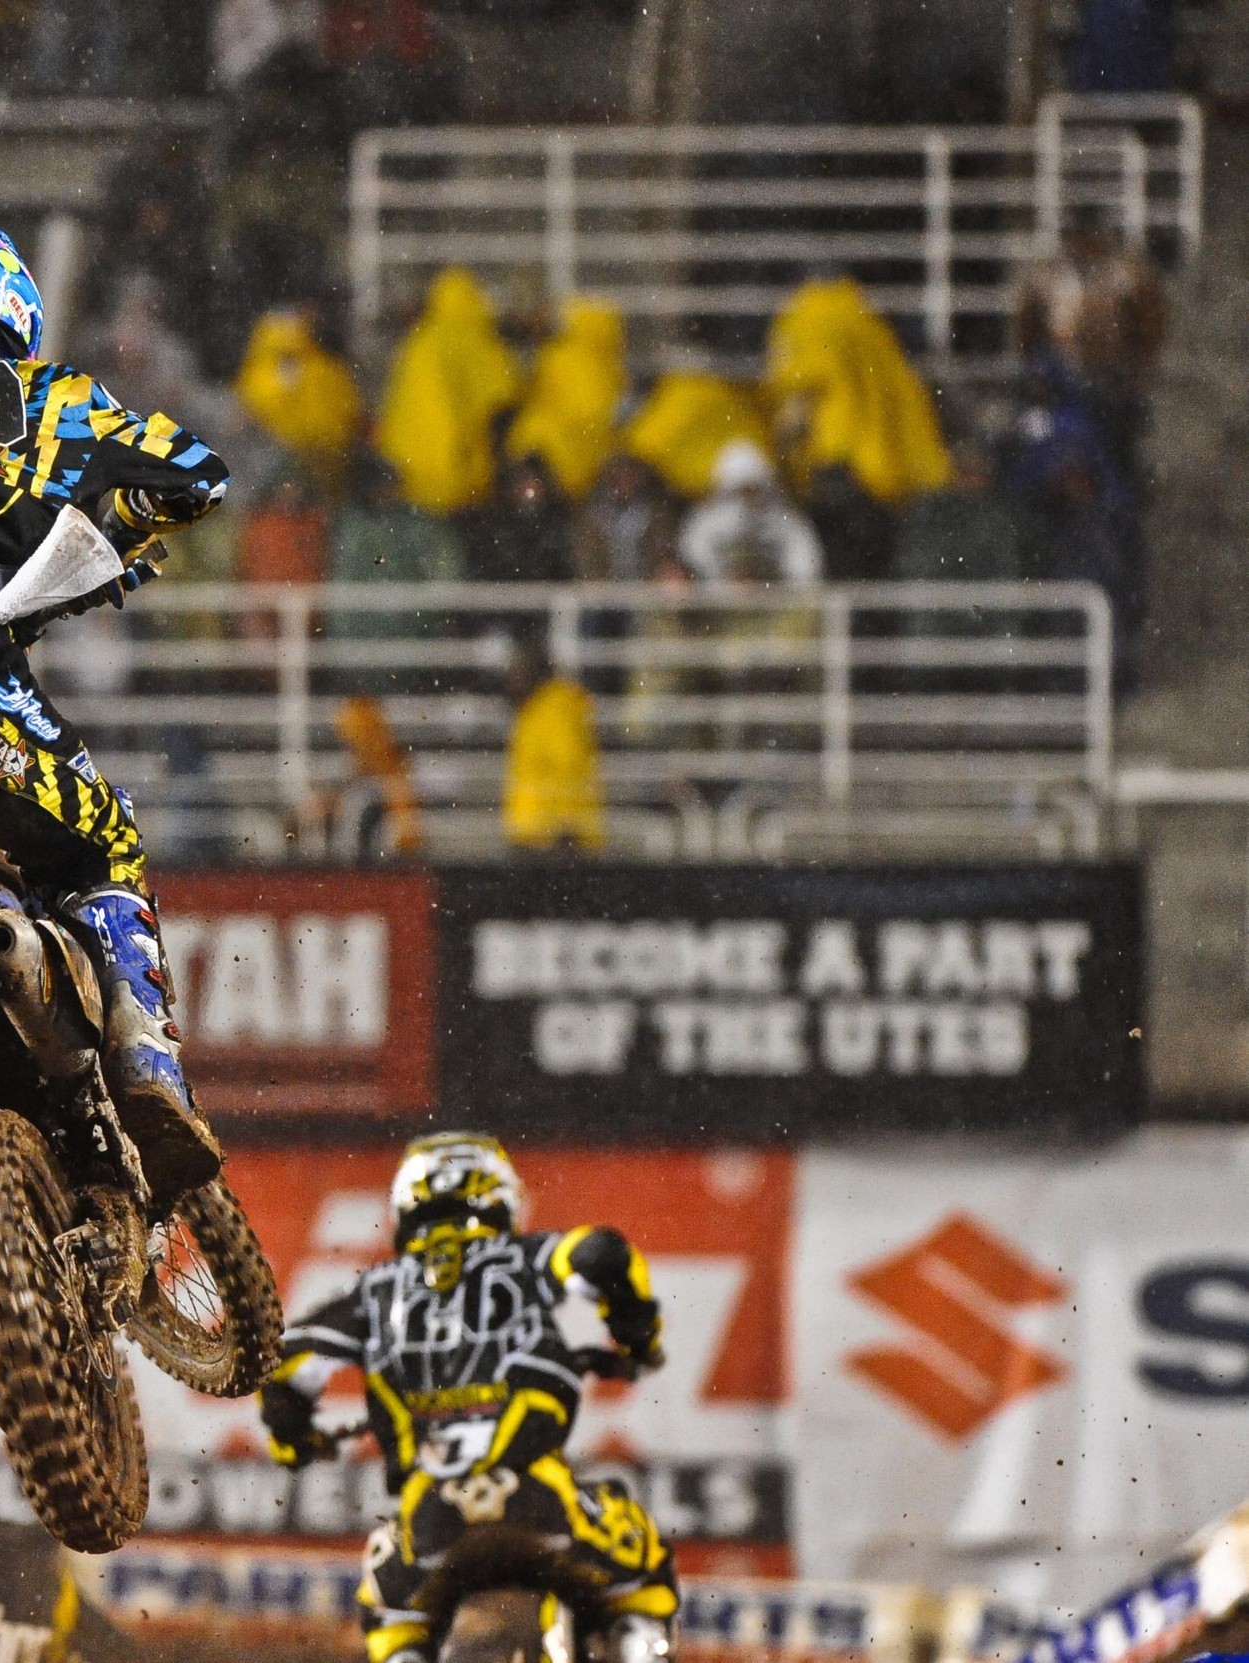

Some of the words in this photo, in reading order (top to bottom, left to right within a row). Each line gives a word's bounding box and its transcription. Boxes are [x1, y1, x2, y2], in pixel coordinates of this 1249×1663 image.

[9, 296, 28, 329] BELL
[473, 918, 786, 999] BECOME
[800, 918, 865, 999] A
[877, 918, 1092, 1000] PART
[536, 1001, 635, 1075] OF
[653, 1001, 809, 1076] THE
[820, 1001, 1030, 1076] UTES
